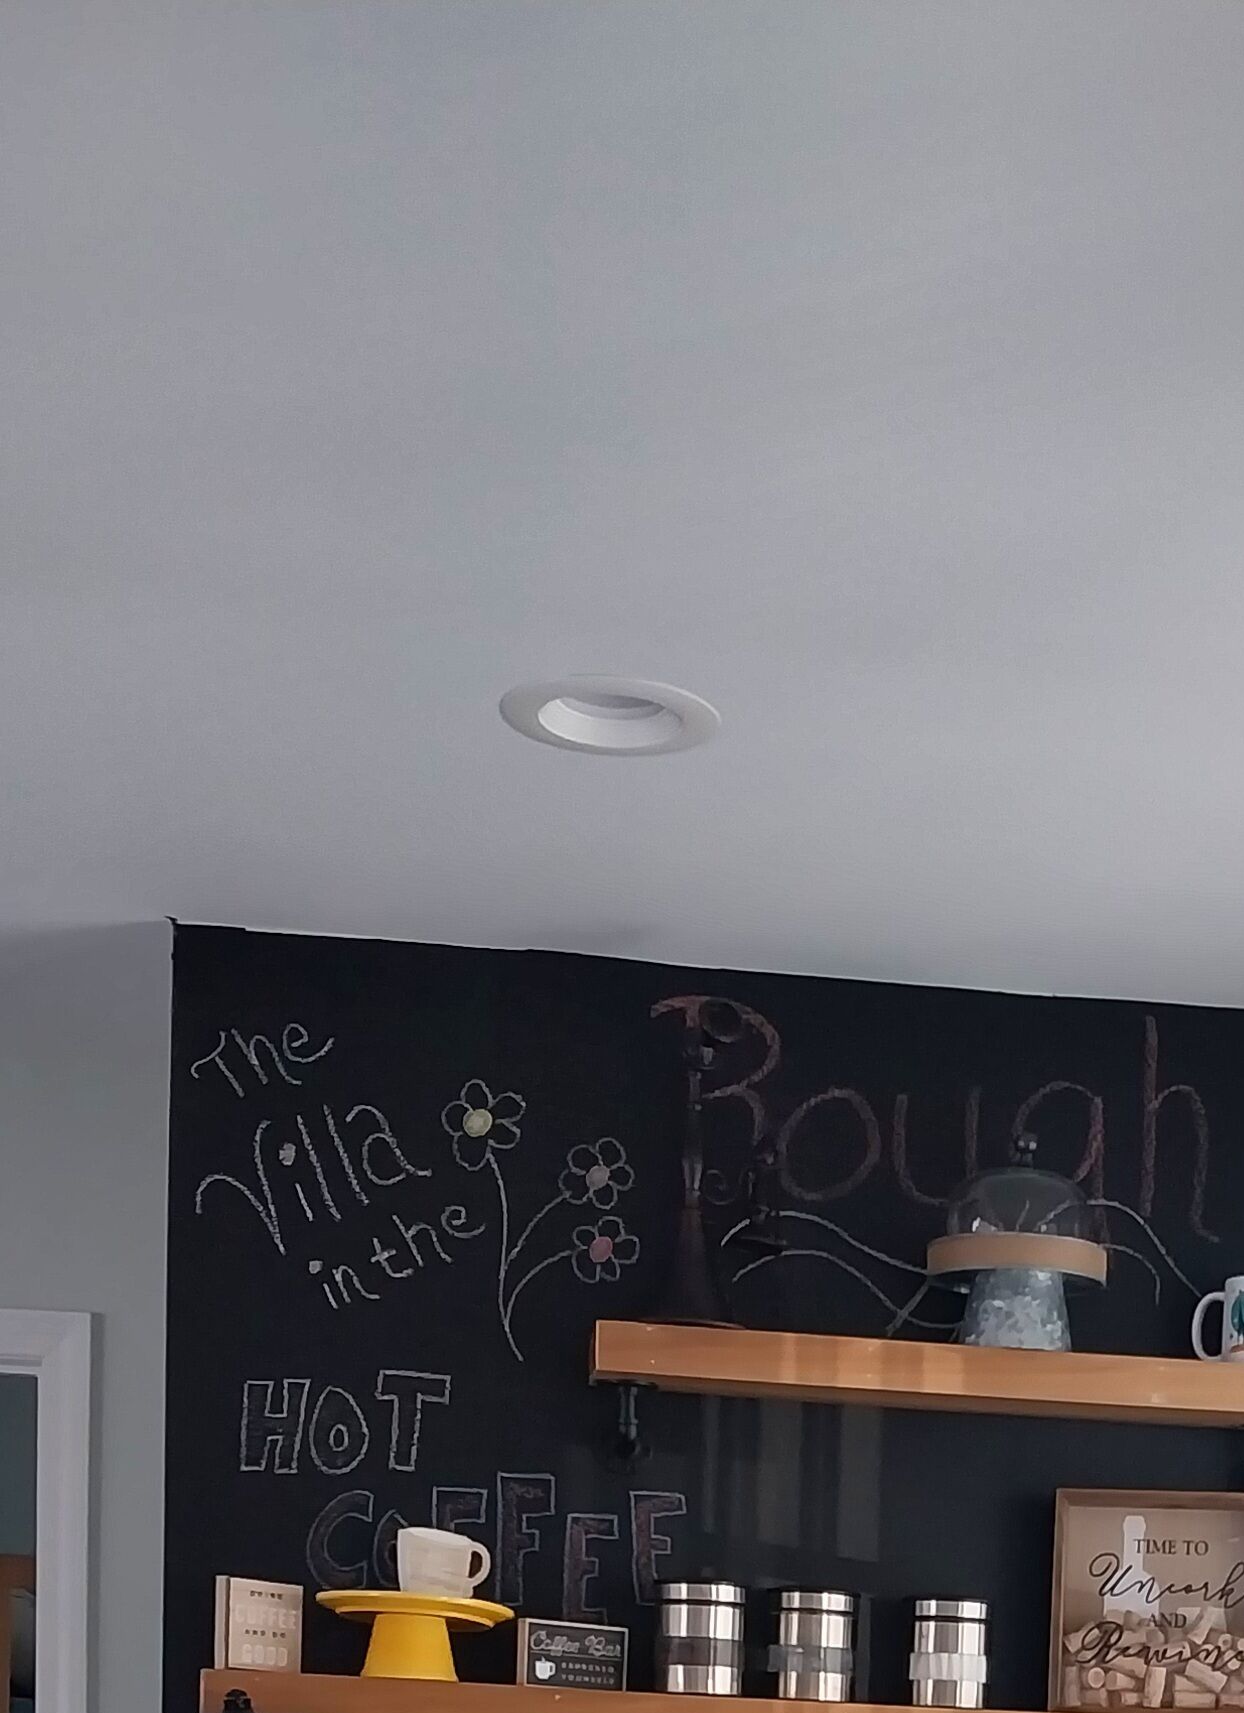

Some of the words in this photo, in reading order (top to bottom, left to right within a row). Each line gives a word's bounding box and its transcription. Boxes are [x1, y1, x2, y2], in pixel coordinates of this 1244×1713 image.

[190, 1023, 335, 1098] The
[195, 1103, 433, 1256] Villa
[308, 1259, 381, 1310] in
[370, 1205, 487, 1279] the
[239, 1369, 452, 1476] HOT
[1133, 1538, 1177, 1555] TIME
[1182, 1540, 1210, 1556] TO
[529, 1629, 581, 1656] Coffee
[1149, 1612, 1188, 1629] AND
